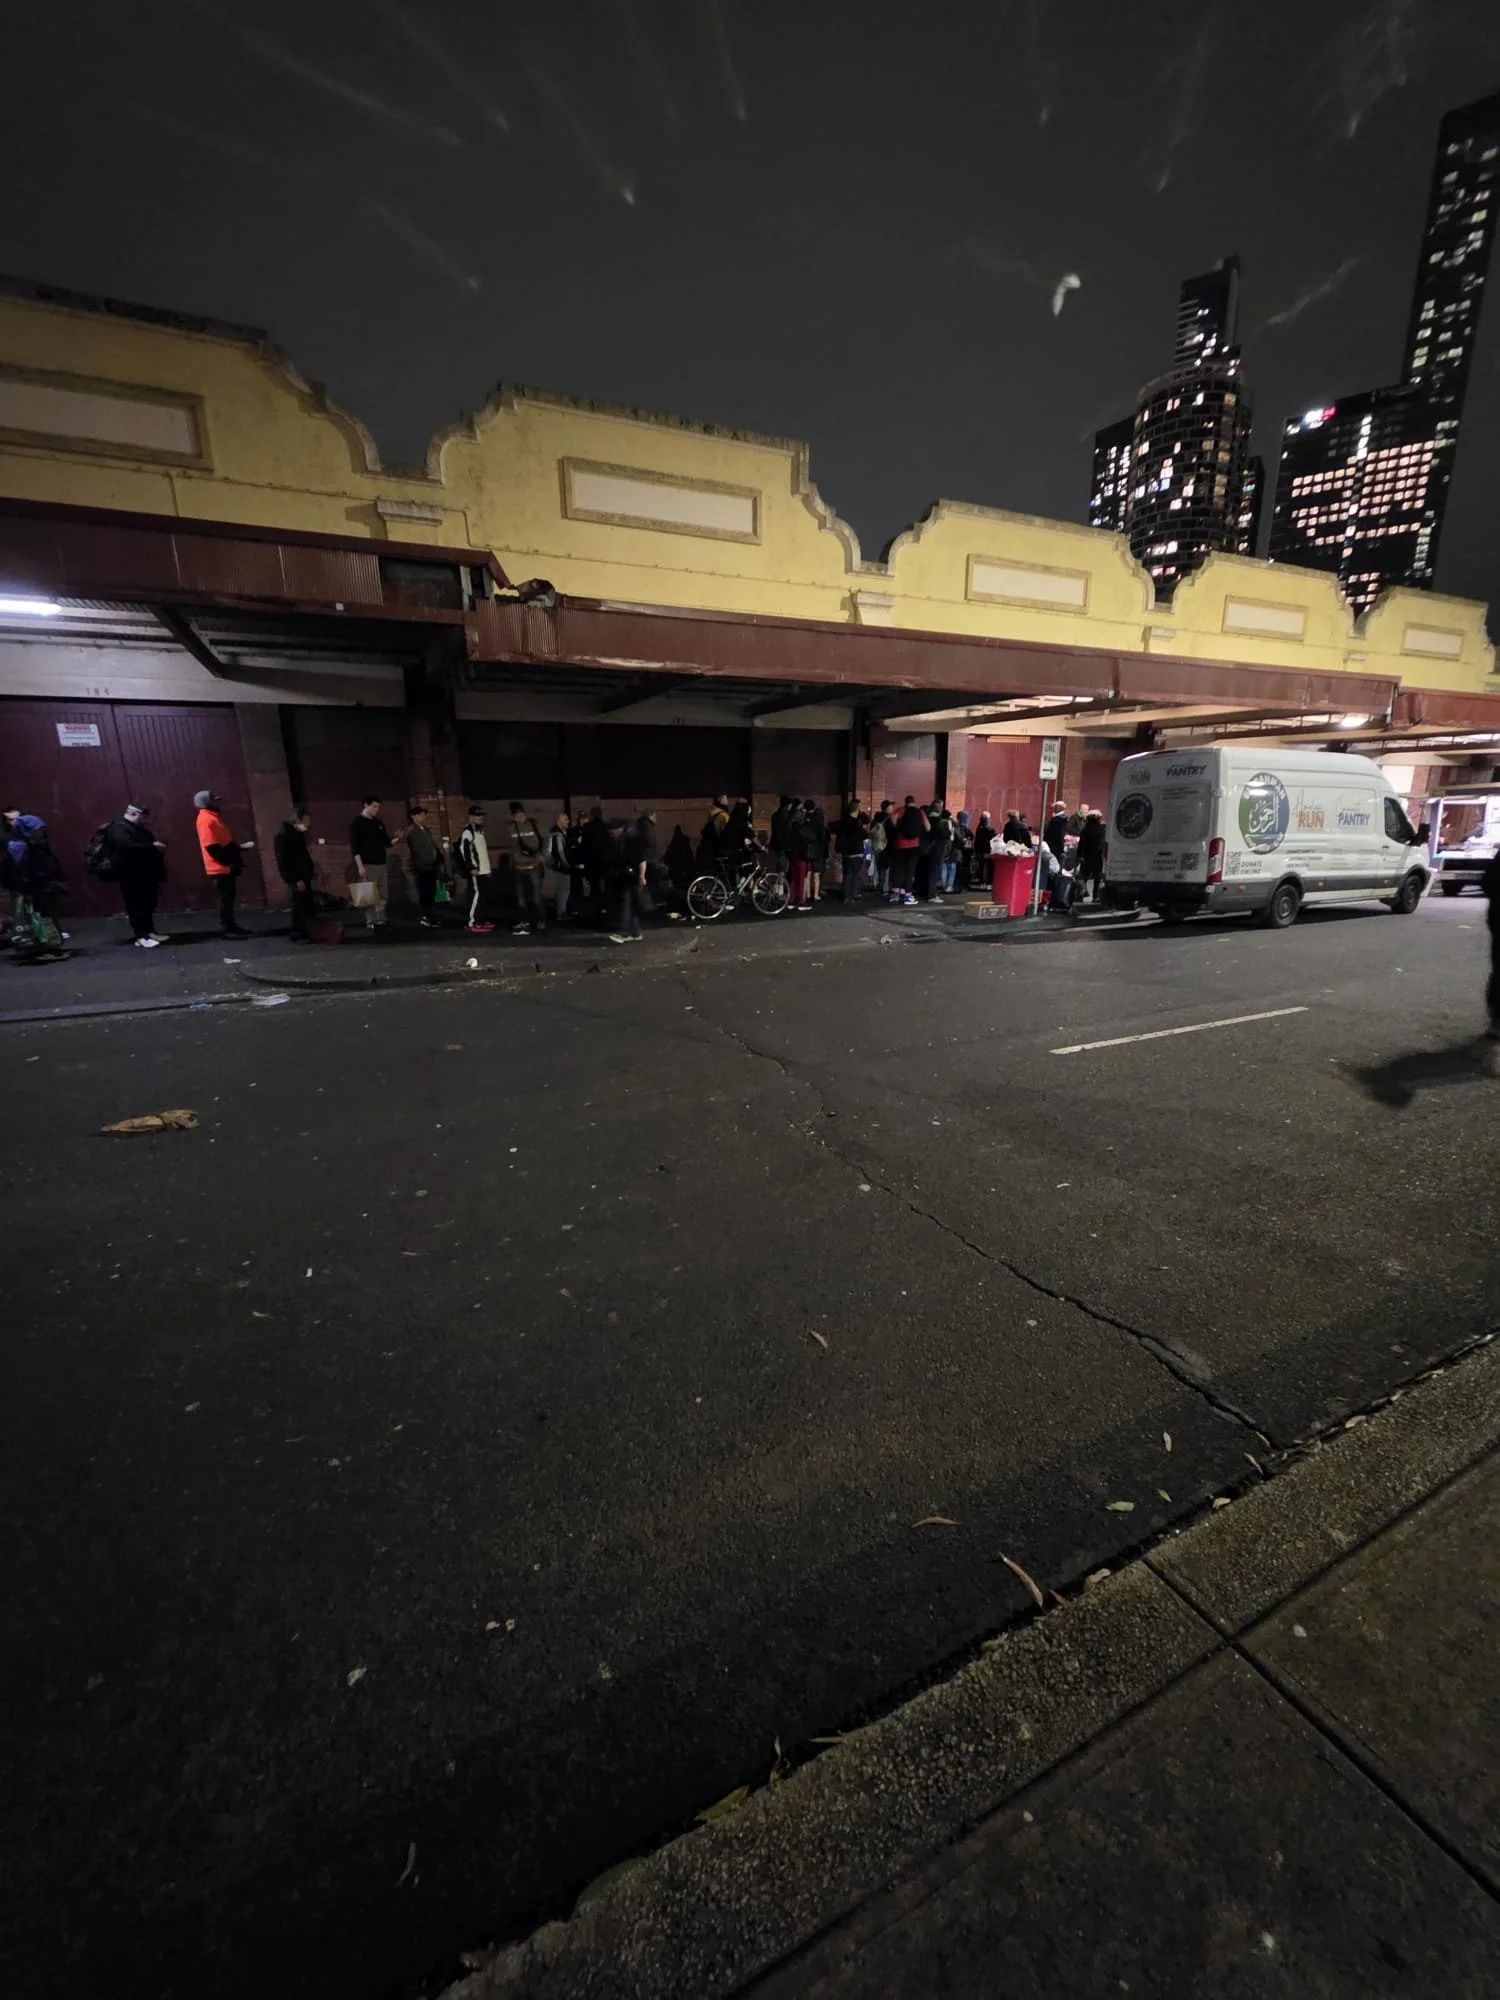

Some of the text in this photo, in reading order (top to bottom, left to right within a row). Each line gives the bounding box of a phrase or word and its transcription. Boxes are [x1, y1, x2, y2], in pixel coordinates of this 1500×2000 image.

[1044, 743, 1056, 752] ONE
[1043, 755, 1056, 764] WAY
[1166, 764, 1207, 777] PANTRY
[1297, 811, 1325, 829] RUN
[1337, 812, 1370, 825] PANTRY
